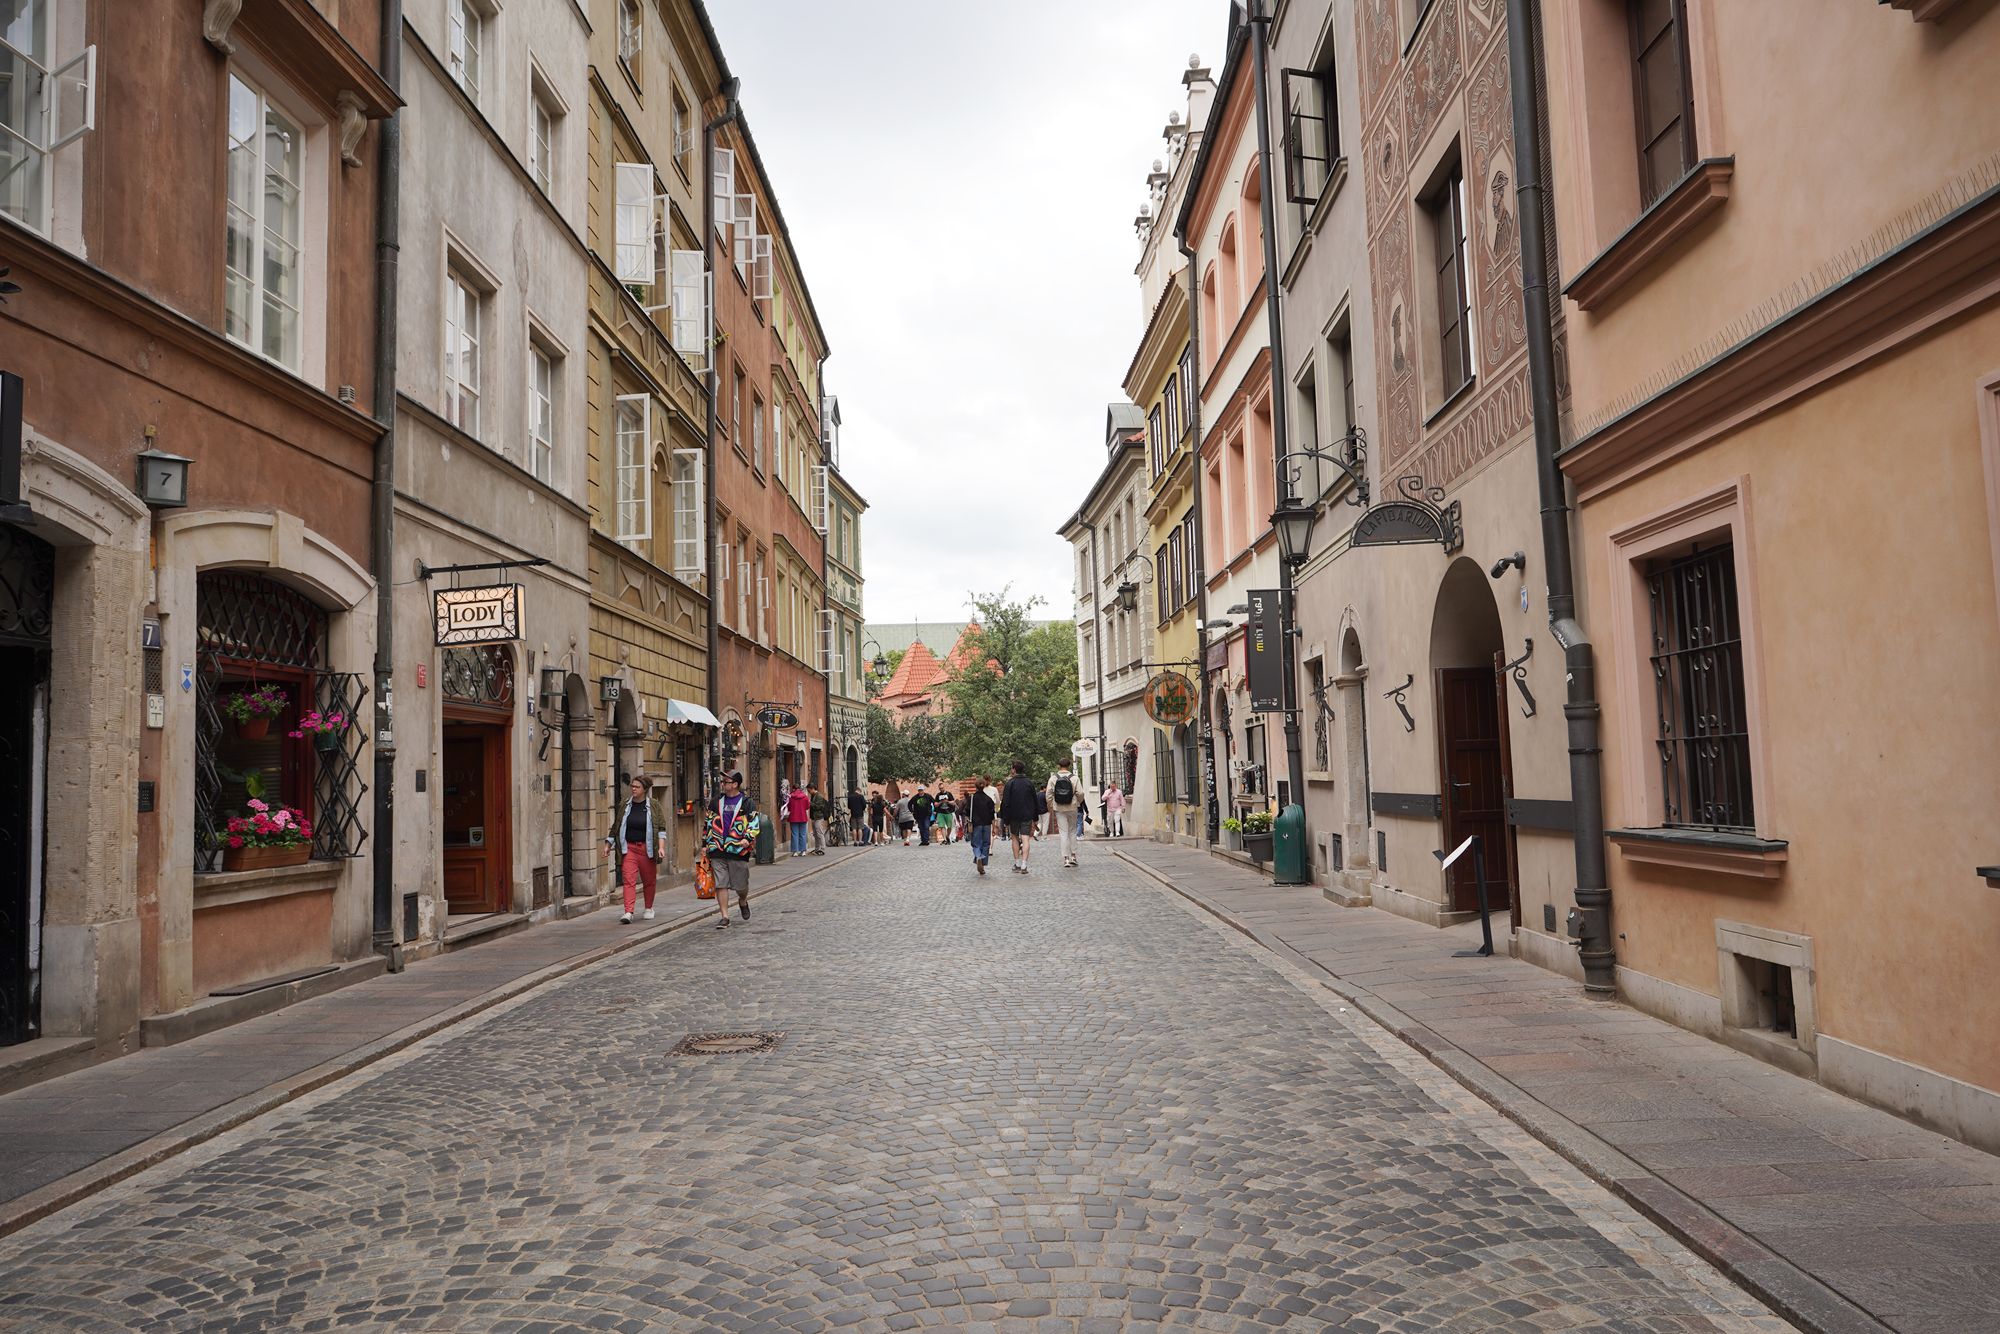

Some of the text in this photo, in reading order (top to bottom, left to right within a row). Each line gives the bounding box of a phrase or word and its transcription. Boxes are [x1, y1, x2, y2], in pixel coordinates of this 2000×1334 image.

[161, 472, 172, 486] 7
[1361, 509, 1434, 536] LAPIDARIUM
[453, 605, 497, 623] LODY
[144, 626, 153, 646] 7
[608, 688, 618, 697] 13
